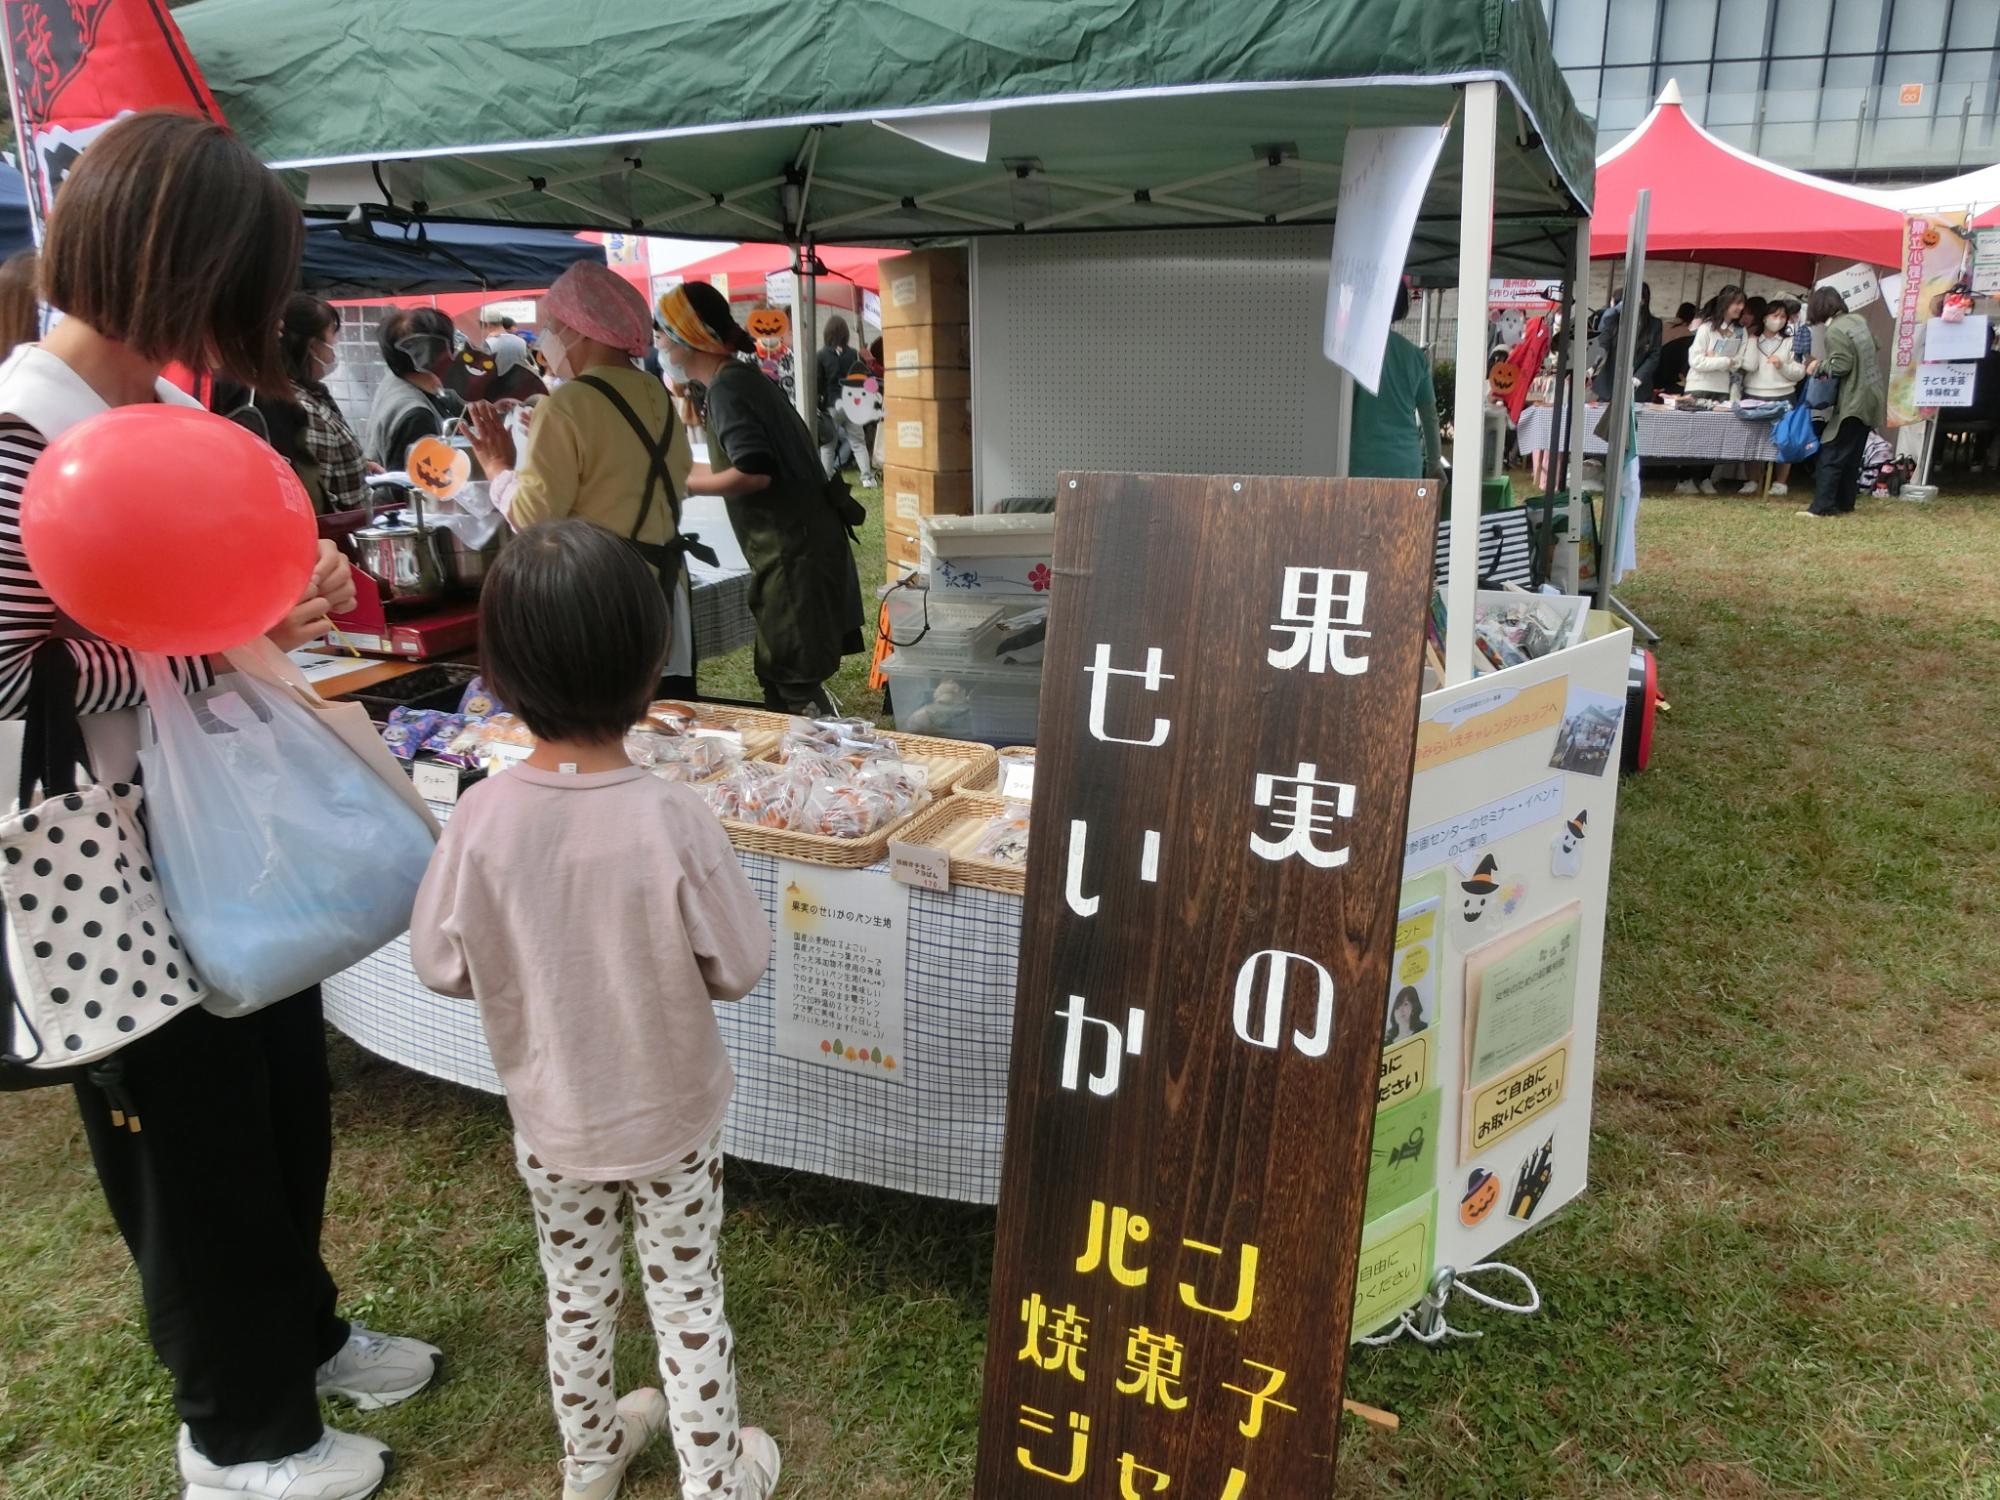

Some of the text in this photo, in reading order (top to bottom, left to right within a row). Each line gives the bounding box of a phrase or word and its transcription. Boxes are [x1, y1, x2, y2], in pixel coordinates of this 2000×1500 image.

[1922, 376, 1968, 386] 子ども手芸
[1416, 703, 1559, 760] みらいえチャレンジショップへ
[1233, 566, 1372, 1058] 果実の
[1404, 787, 1559, 856] 参画センターのセミナー・イベント
[1054, 643, 1175, 1097] せいか
[792, 901, 891, 928] 果実のせいかのパン生地
[1478, 1079, 1559, 1140] お取りください
[1496, 1065, 1548, 1106] ご自由に
[1076, 1200, 1259, 1322] パン
[1018, 1293, 1297, 1439] 焼菓子
